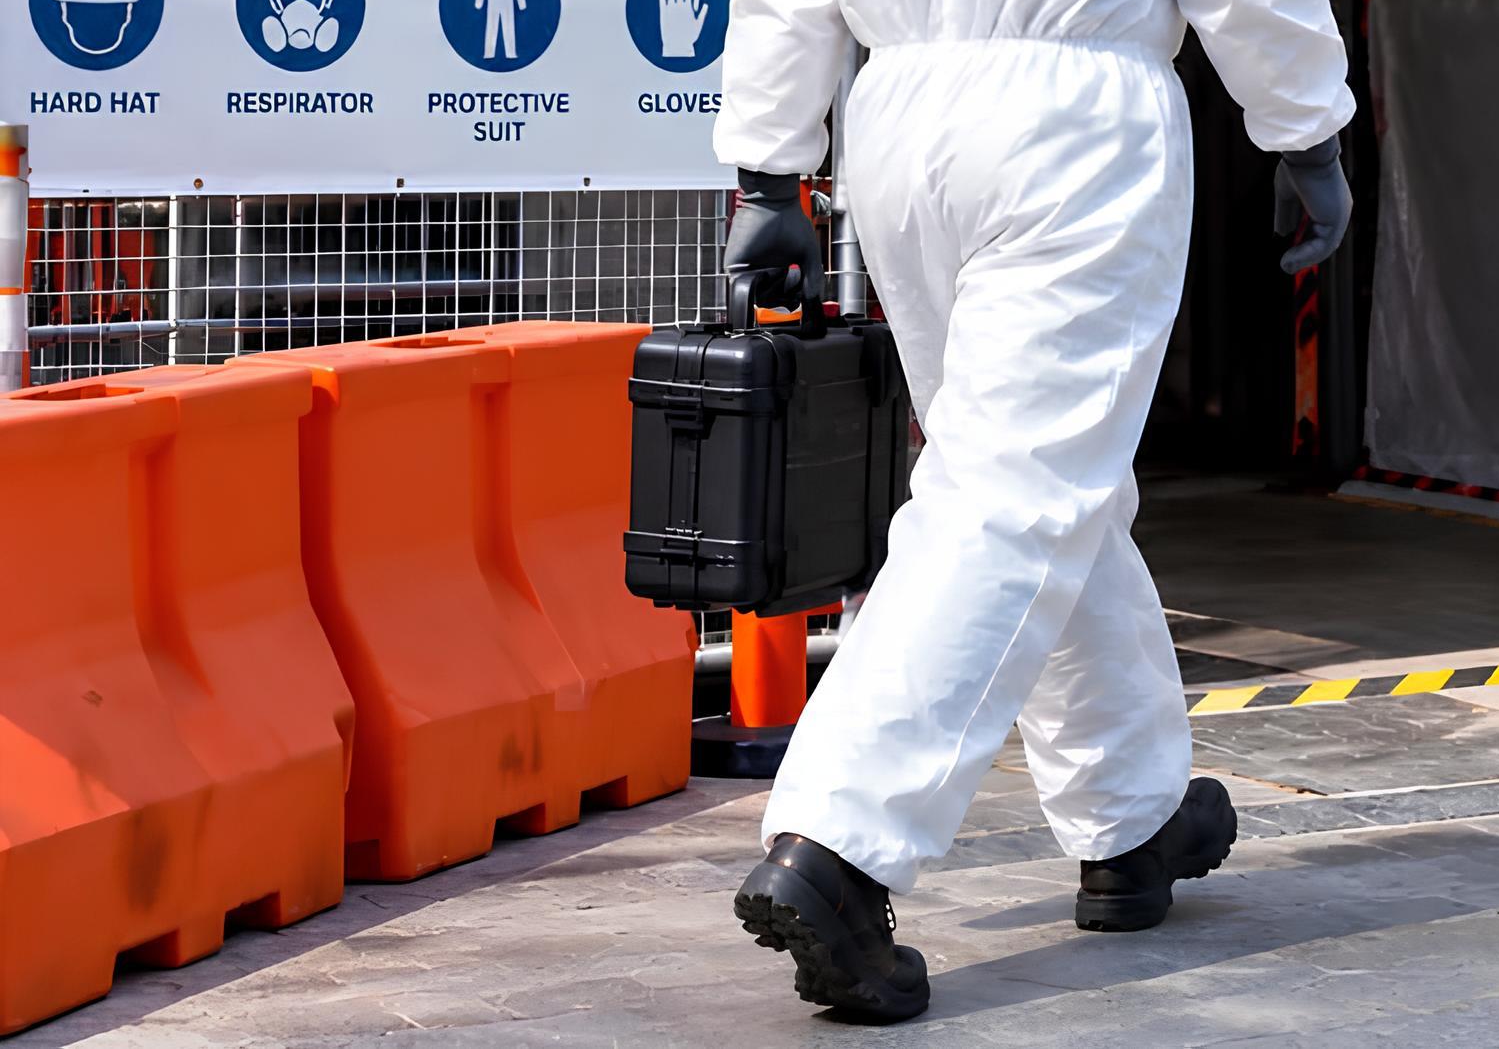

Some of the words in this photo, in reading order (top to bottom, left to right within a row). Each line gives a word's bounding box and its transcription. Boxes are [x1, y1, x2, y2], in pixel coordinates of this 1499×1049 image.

[31, 92, 101, 113] HARD
[111, 92, 160, 113] HAT
[227, 93, 373, 113] RESPIRATOR
[429, 93, 569, 113] PROTECTIVE
[638, 93, 721, 113] GLOVES
[474, 122, 525, 141] SUIT
